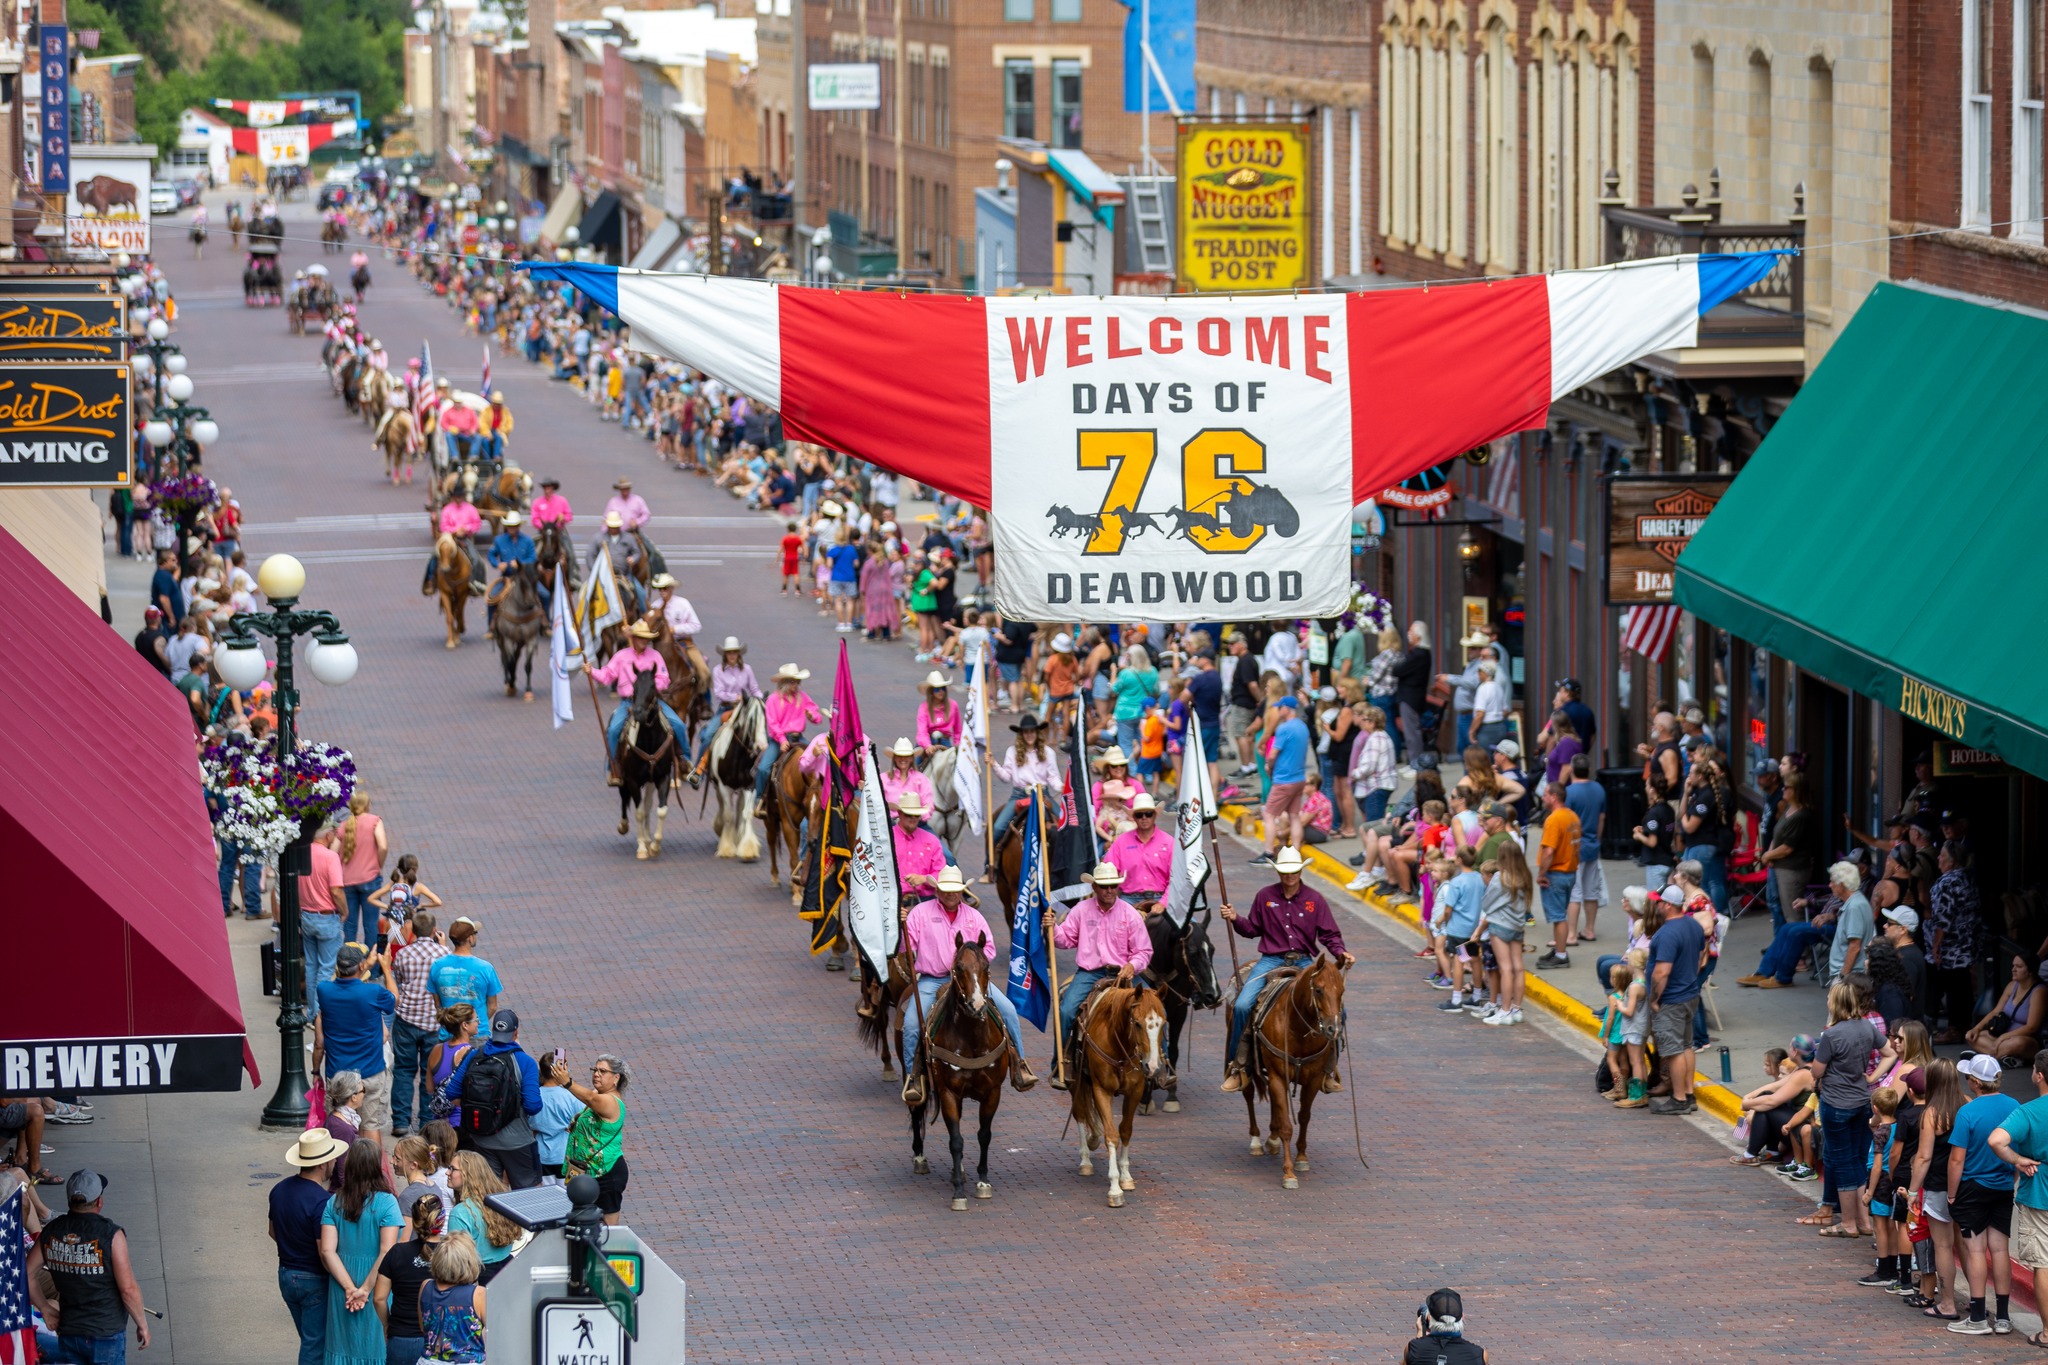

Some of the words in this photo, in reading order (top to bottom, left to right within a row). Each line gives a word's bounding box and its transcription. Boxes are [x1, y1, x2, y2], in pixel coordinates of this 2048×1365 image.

[45, 35, 65, 181] BODEGA
[1205, 138, 1284, 169] GOLD
[1192, 184, 1297, 220] NUGGET
[71, 231, 145, 250] SALOON
[1193, 238, 1297, 258] TRADING
[1209, 261, 1276, 280] POST
[42, 307, 118, 337] Dust
[1005, 315, 1332, 384] WELCOME
[13, 382, 124, 427] Dust
[1072, 382, 1193, 414] DAYS
[1214, 382, 1266, 412] OF
[1076, 427, 1267, 556] 76
[1047, 571, 1303, 604] DEADWOOD
[1900, 675, 1967, 739] HICKOK'S
[1951, 750, 1989, 764] HOTEL
[879, 866, 891, 893] THE
[882, 897, 891, 933] YEAR
[5, 1043, 177, 1090] REWERY
[46, 1247, 100, 1264] DAVIDSON
[51, 1238, 95, 1255] HARLEY-
[47, 1261, 105, 1275] MOTORCYCLES
[558, 1354, 610, 1365] WATCH
